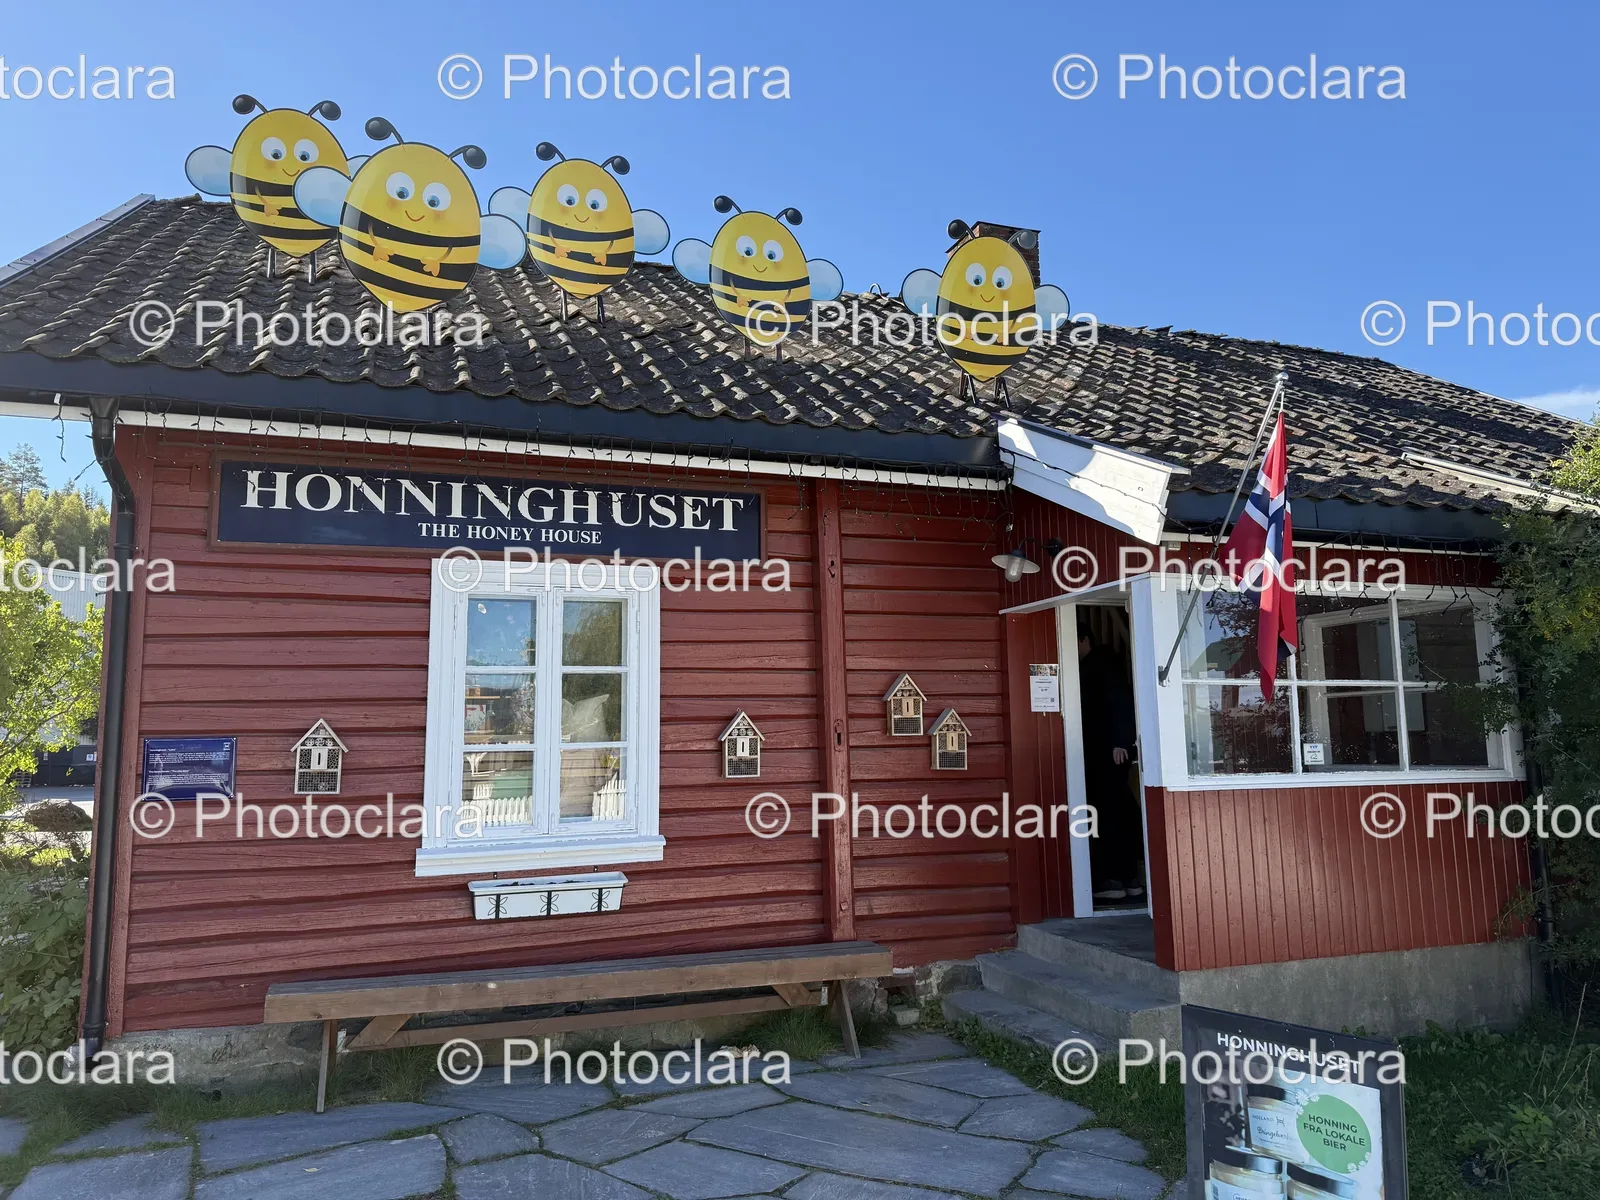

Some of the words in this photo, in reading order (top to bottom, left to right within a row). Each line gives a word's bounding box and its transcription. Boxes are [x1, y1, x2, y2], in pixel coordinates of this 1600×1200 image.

[240, 469, 744, 532] HONNINGHUSET
[418, 523, 460, 538] THE
[467, 525, 534, 542] HONEY
[540, 528, 602, 544] HOUSE
[1217, 1032, 1360, 1075] HONNINGHUSET
[1303, 1122, 1323, 1135] FRA
[1325, 1128, 1365, 1147] LOKALE
[1308, 1114, 1358, 1133] HONNING
[1323, 1138, 1347, 1151] BIER
